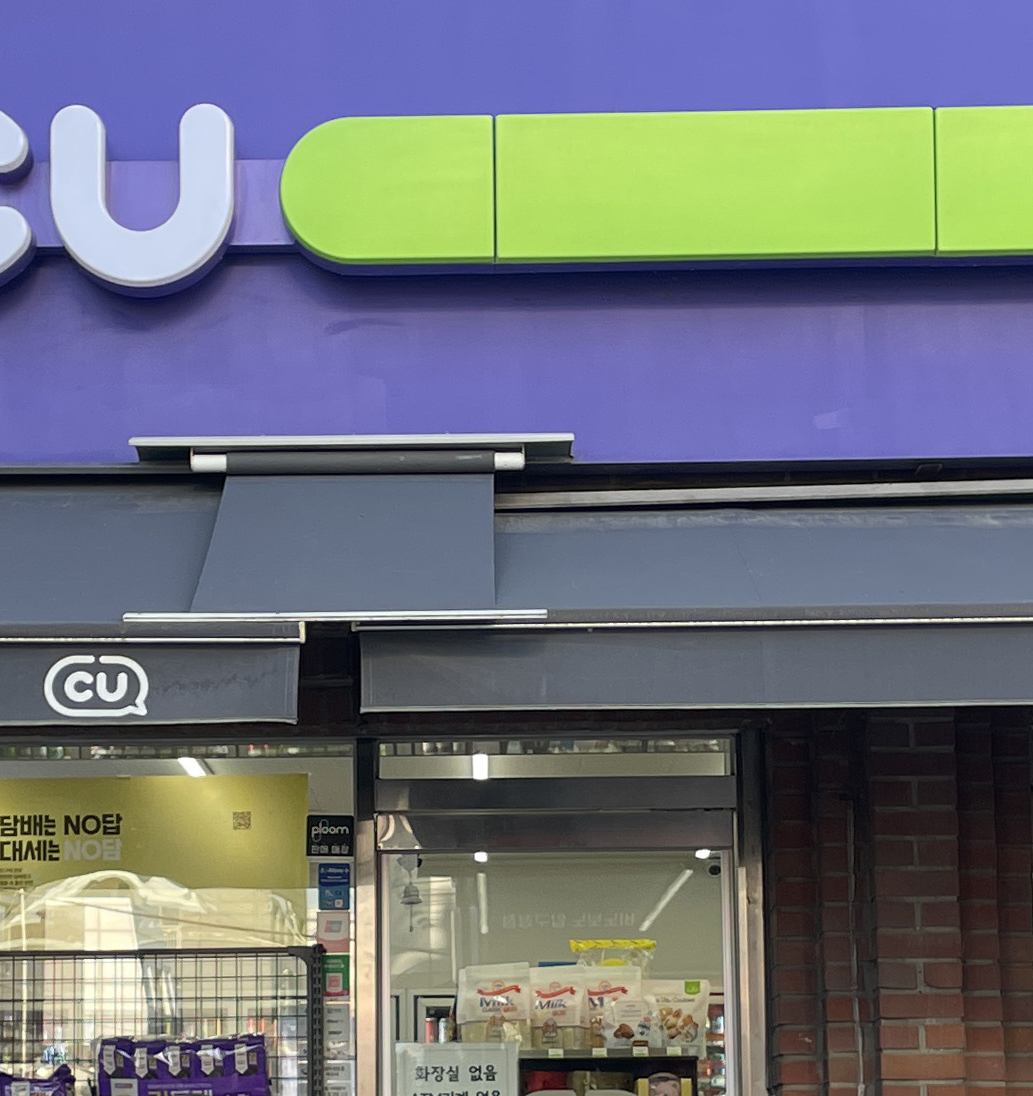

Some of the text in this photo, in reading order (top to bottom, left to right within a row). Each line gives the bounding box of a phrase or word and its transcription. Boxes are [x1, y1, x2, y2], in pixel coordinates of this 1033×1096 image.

[64, 670, 128, 702] CU
[0, 813, 123, 837] 담배는 NO답
[311, 820, 349, 842] ploom
[0, 840, 60, 862] 대세는
[415, 1064, 497, 1082] 화장실 없음
